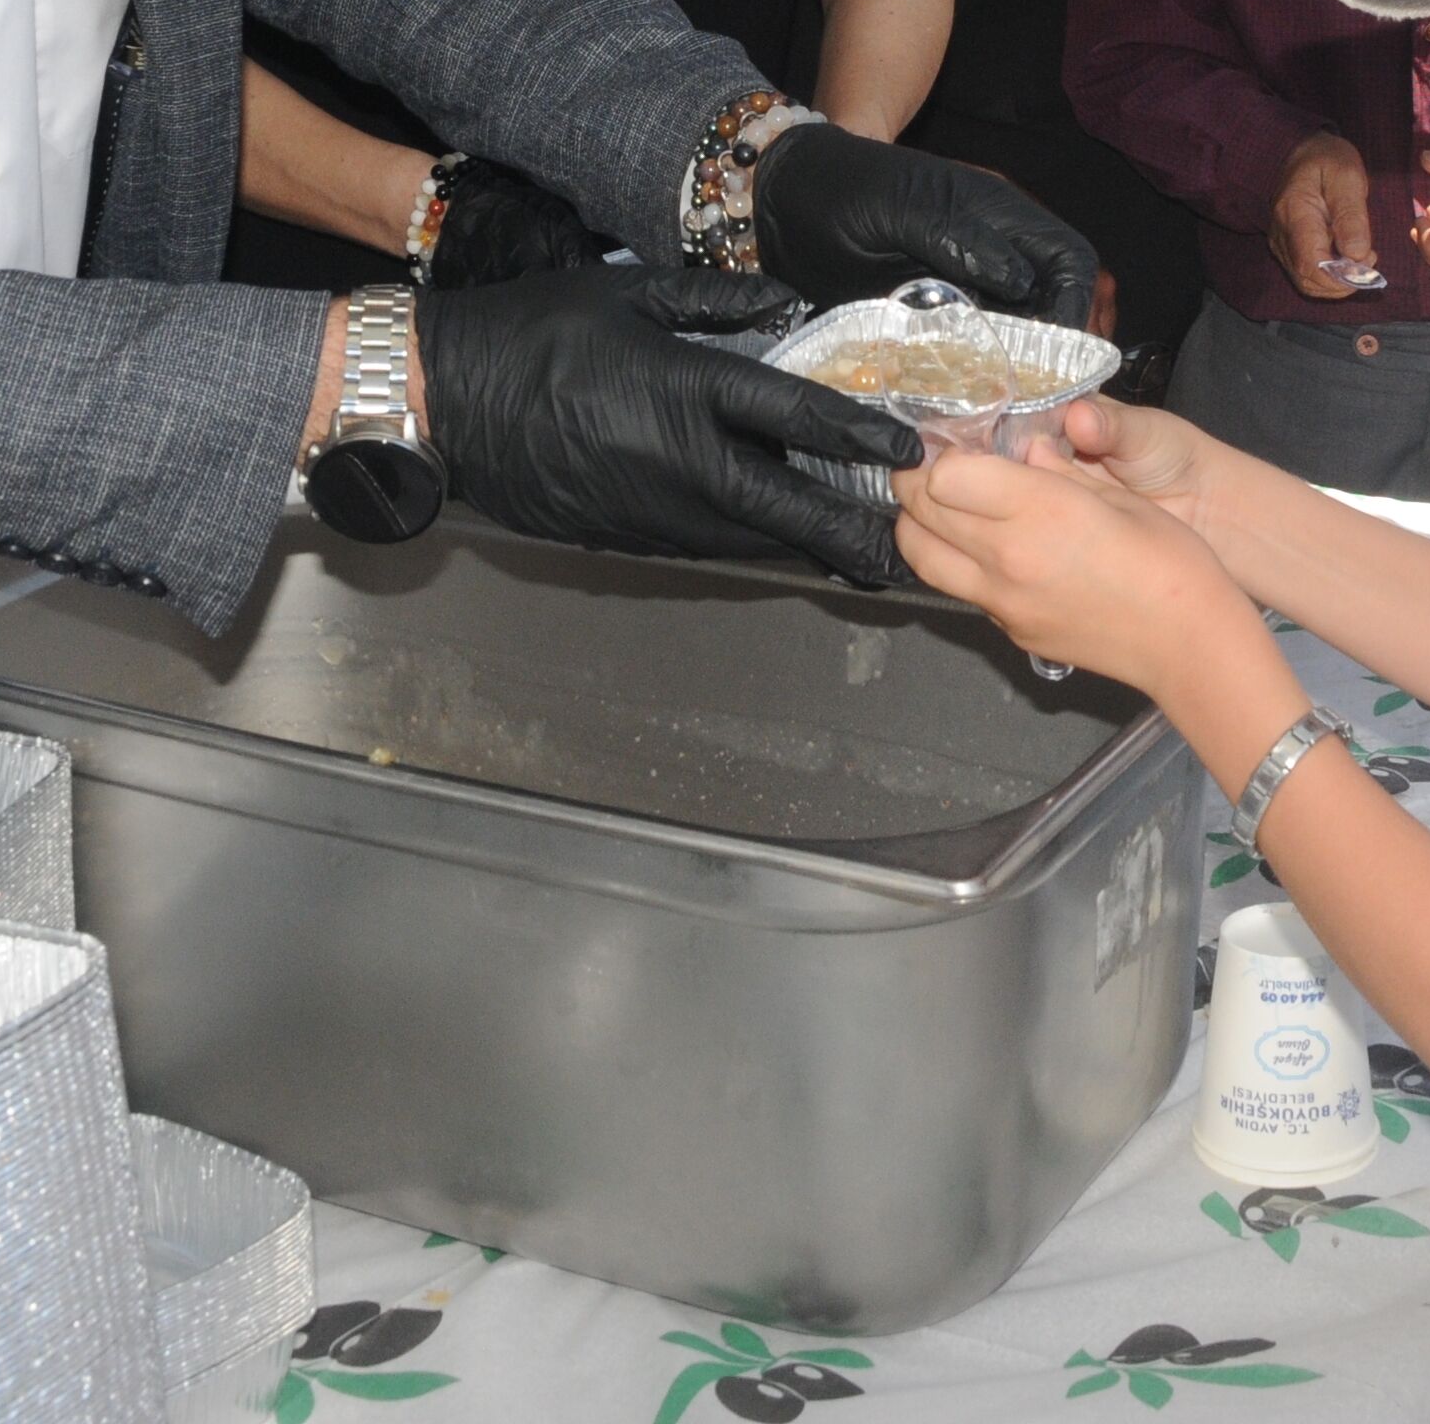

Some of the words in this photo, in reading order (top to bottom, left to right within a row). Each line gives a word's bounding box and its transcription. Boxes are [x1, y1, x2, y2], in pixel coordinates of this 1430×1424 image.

[1260, 992, 1278, 1003] 09
[1281, 993, 1298, 1004] 40
[1300, 991, 1325, 1003] 444
[1272, 1053, 1314, 1067] Afiyet
[1232, 1085, 1315, 1105] BELEDİYESİ
[1219, 1094, 1331, 1122] BÜYÜKŞEHİR
[1235, 1117, 1279, 1135] AYDIN
